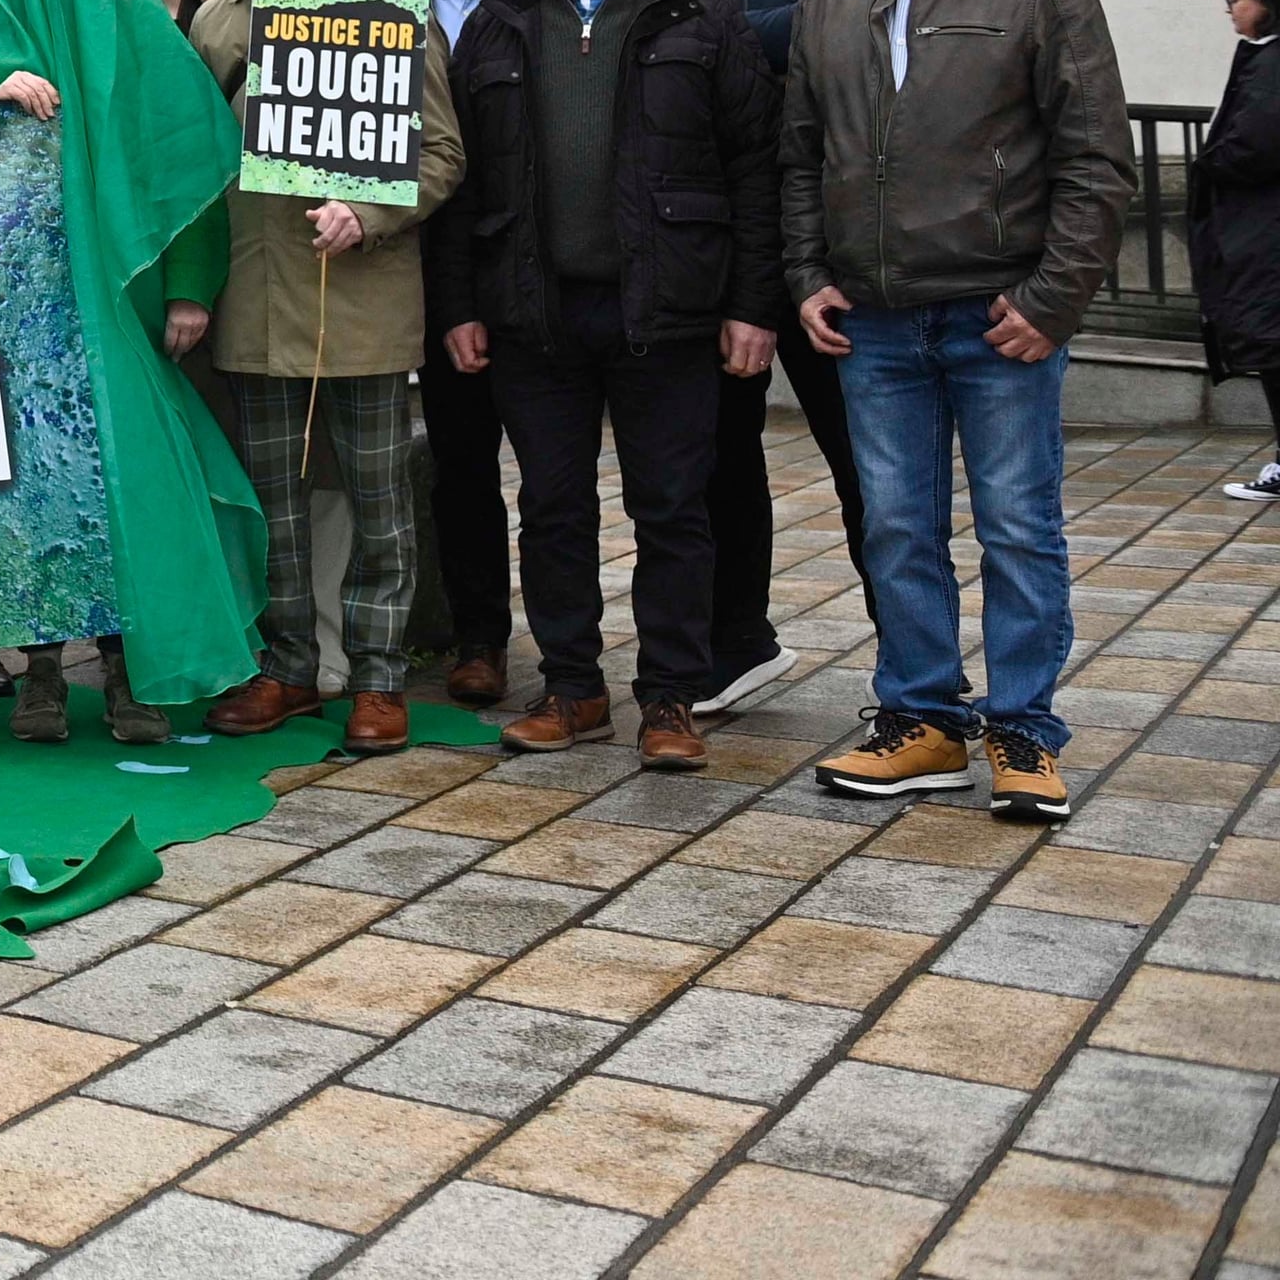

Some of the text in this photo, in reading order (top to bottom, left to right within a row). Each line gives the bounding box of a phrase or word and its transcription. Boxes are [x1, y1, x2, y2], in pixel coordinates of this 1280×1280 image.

[264, 12, 415, 51] JUSTICE FOR
[260, 44, 412, 106] LOUGH
[257, 102, 410, 165] NEAGH
